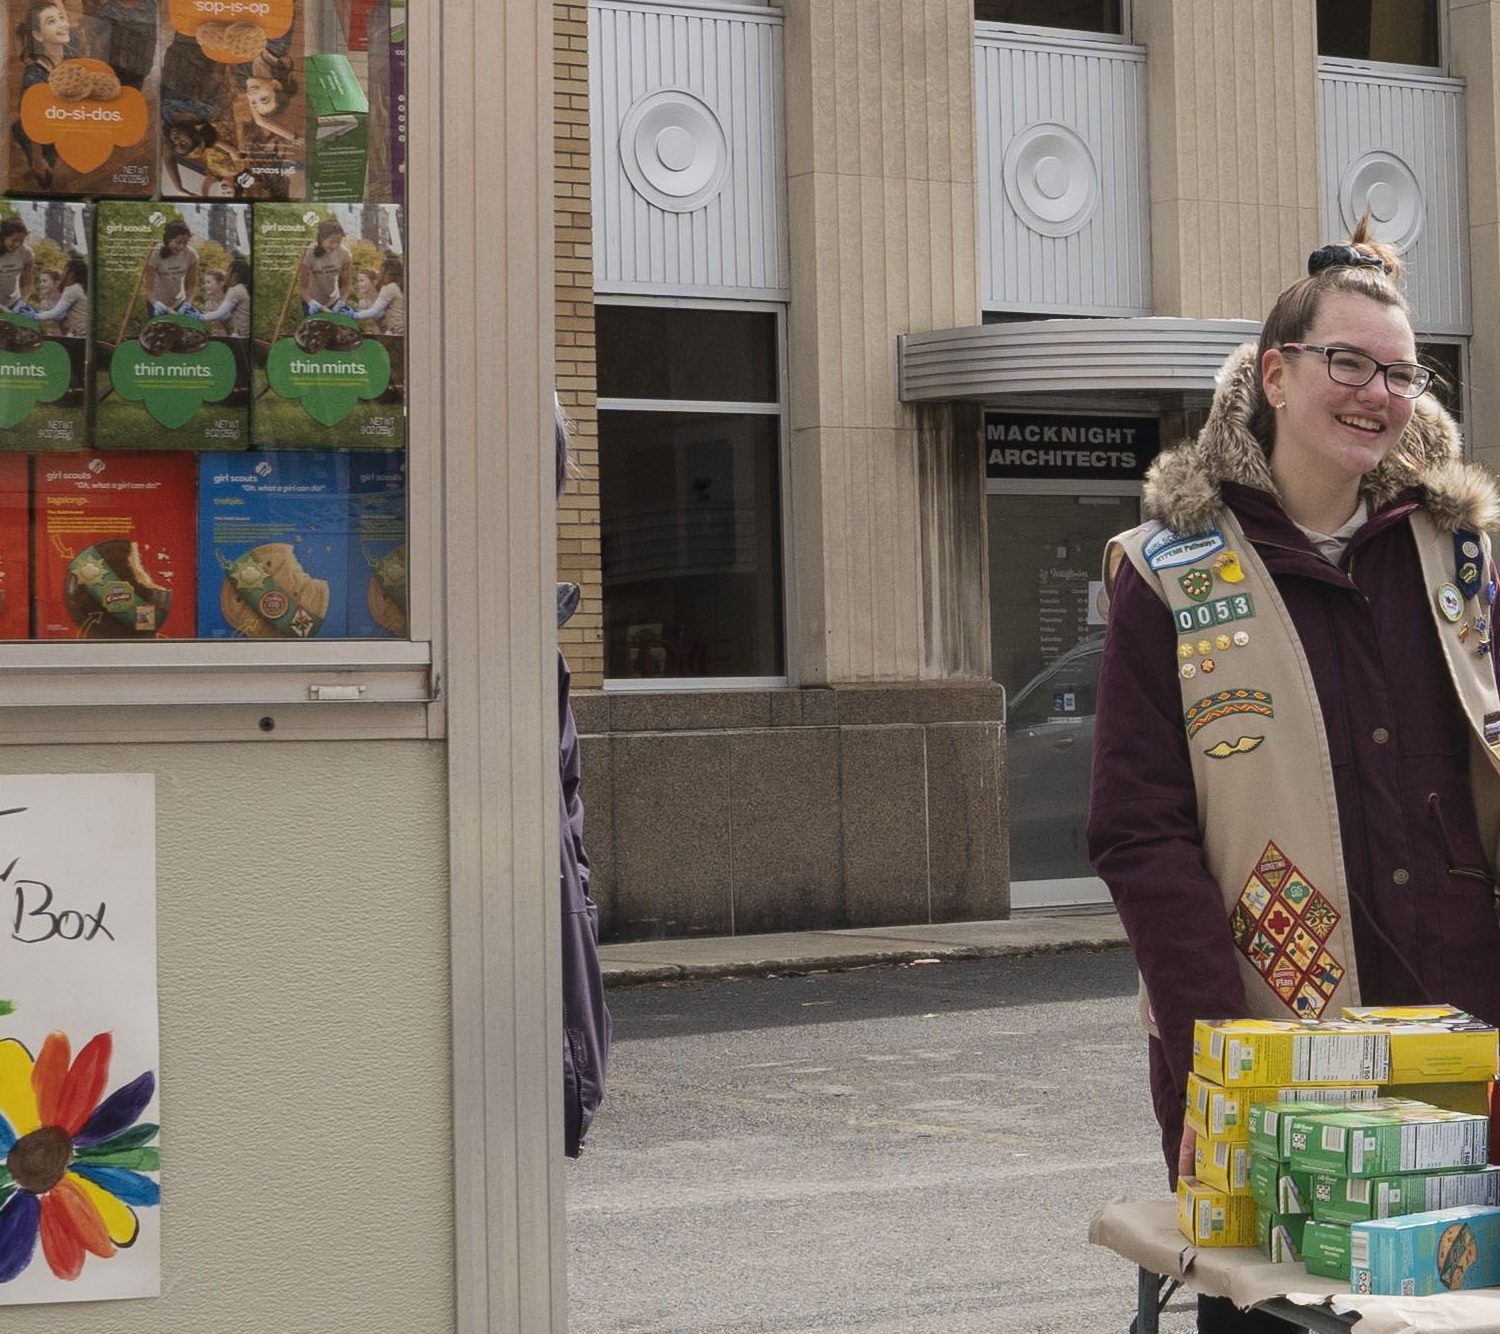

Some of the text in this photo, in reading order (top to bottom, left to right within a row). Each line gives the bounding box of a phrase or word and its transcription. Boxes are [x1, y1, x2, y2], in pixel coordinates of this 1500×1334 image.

[195, 1, 270, 16] do-si-dos
[45, 105, 122, 122] do-si-dos
[106, 221, 151, 234] girl scouts
[278, 224, 306, 232] scouts
[1, 362, 46, 377] mints
[134, 362, 212, 377] thin mints
[290, 360, 366, 375] thin mints
[987, 425, 1136, 444] MACKNIGHT
[988, 449, 1137, 468] ARCHITECTS
[46, 471, 92, 481] girl scouts
[214, 474, 229, 484] girl
[1179, 597, 1249, 629] 0053
[10, 880, 115, 943] Box
